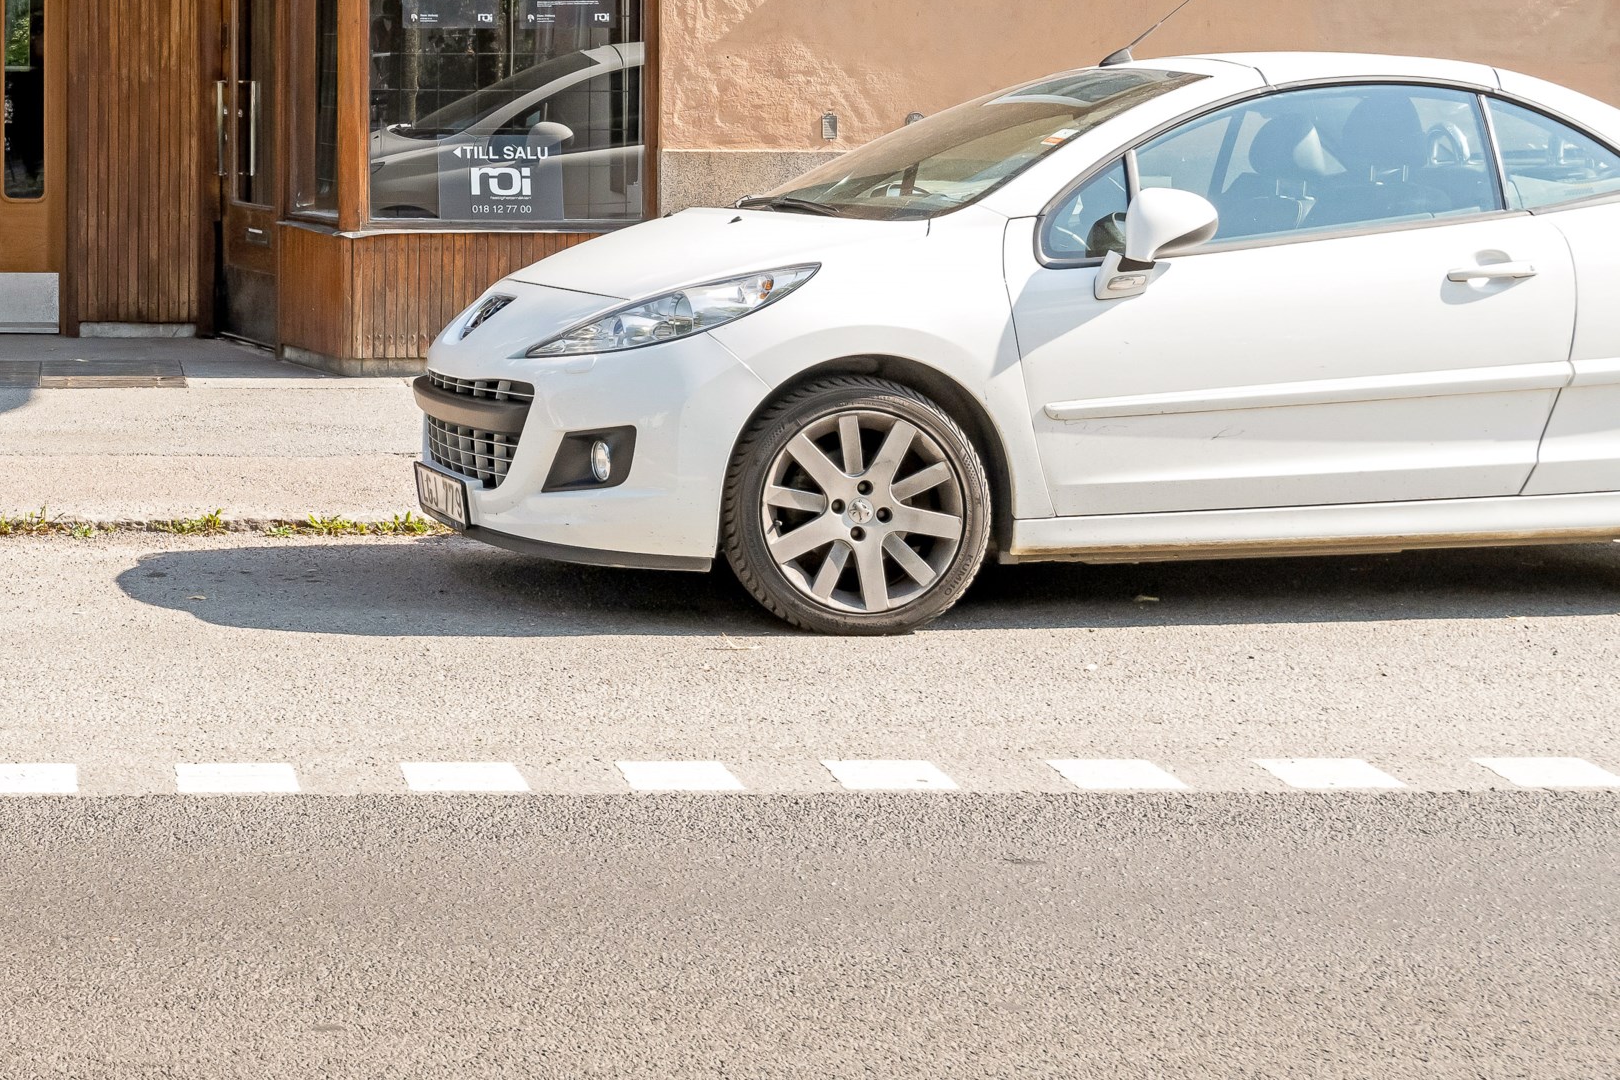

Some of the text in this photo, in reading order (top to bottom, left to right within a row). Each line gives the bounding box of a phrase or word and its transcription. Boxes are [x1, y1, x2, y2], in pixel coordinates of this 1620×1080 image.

[463, 146, 548, 159] TILL SALU
[470, 167, 531, 195] roi
[472, 205, 532, 213] 018 12 77 00
[420, 470, 463, 519] LGJ 779
